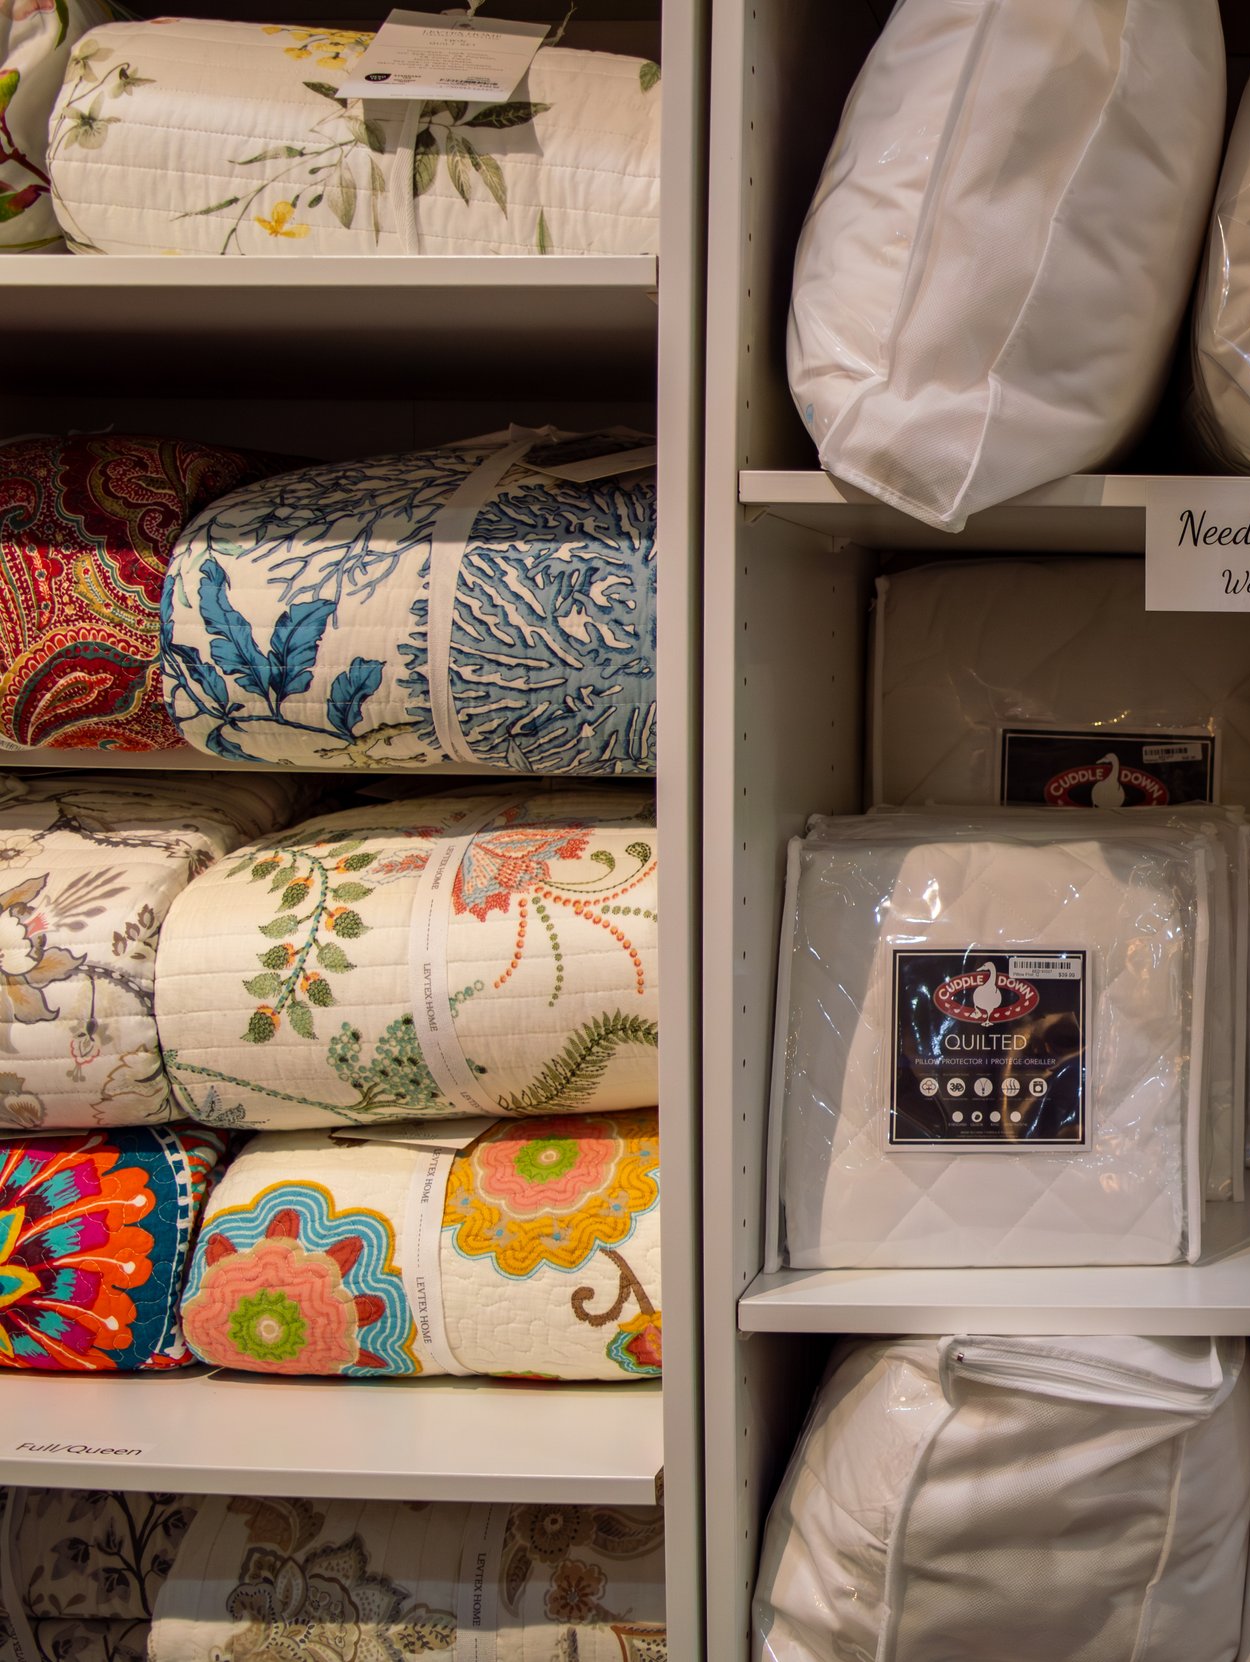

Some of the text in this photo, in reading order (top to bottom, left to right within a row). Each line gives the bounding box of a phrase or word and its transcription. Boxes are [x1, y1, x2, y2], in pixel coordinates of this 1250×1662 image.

[1050, 769, 1163, 798] CUDDLE DOWN
[423, 962, 438, 1032] LEVTEX HOME
[938, 975, 1034, 1001] CUDDLE DOWN
[944, 1034, 1027, 1051] QUILTED
[420, 1177, 434, 1204] HOME
[416, 1276, 433, 1344] LEVTEX HOME
[15, 1442, 143, 1456] Full/Queen
[472, 1552, 487, 1627] LEVTEX HOME
